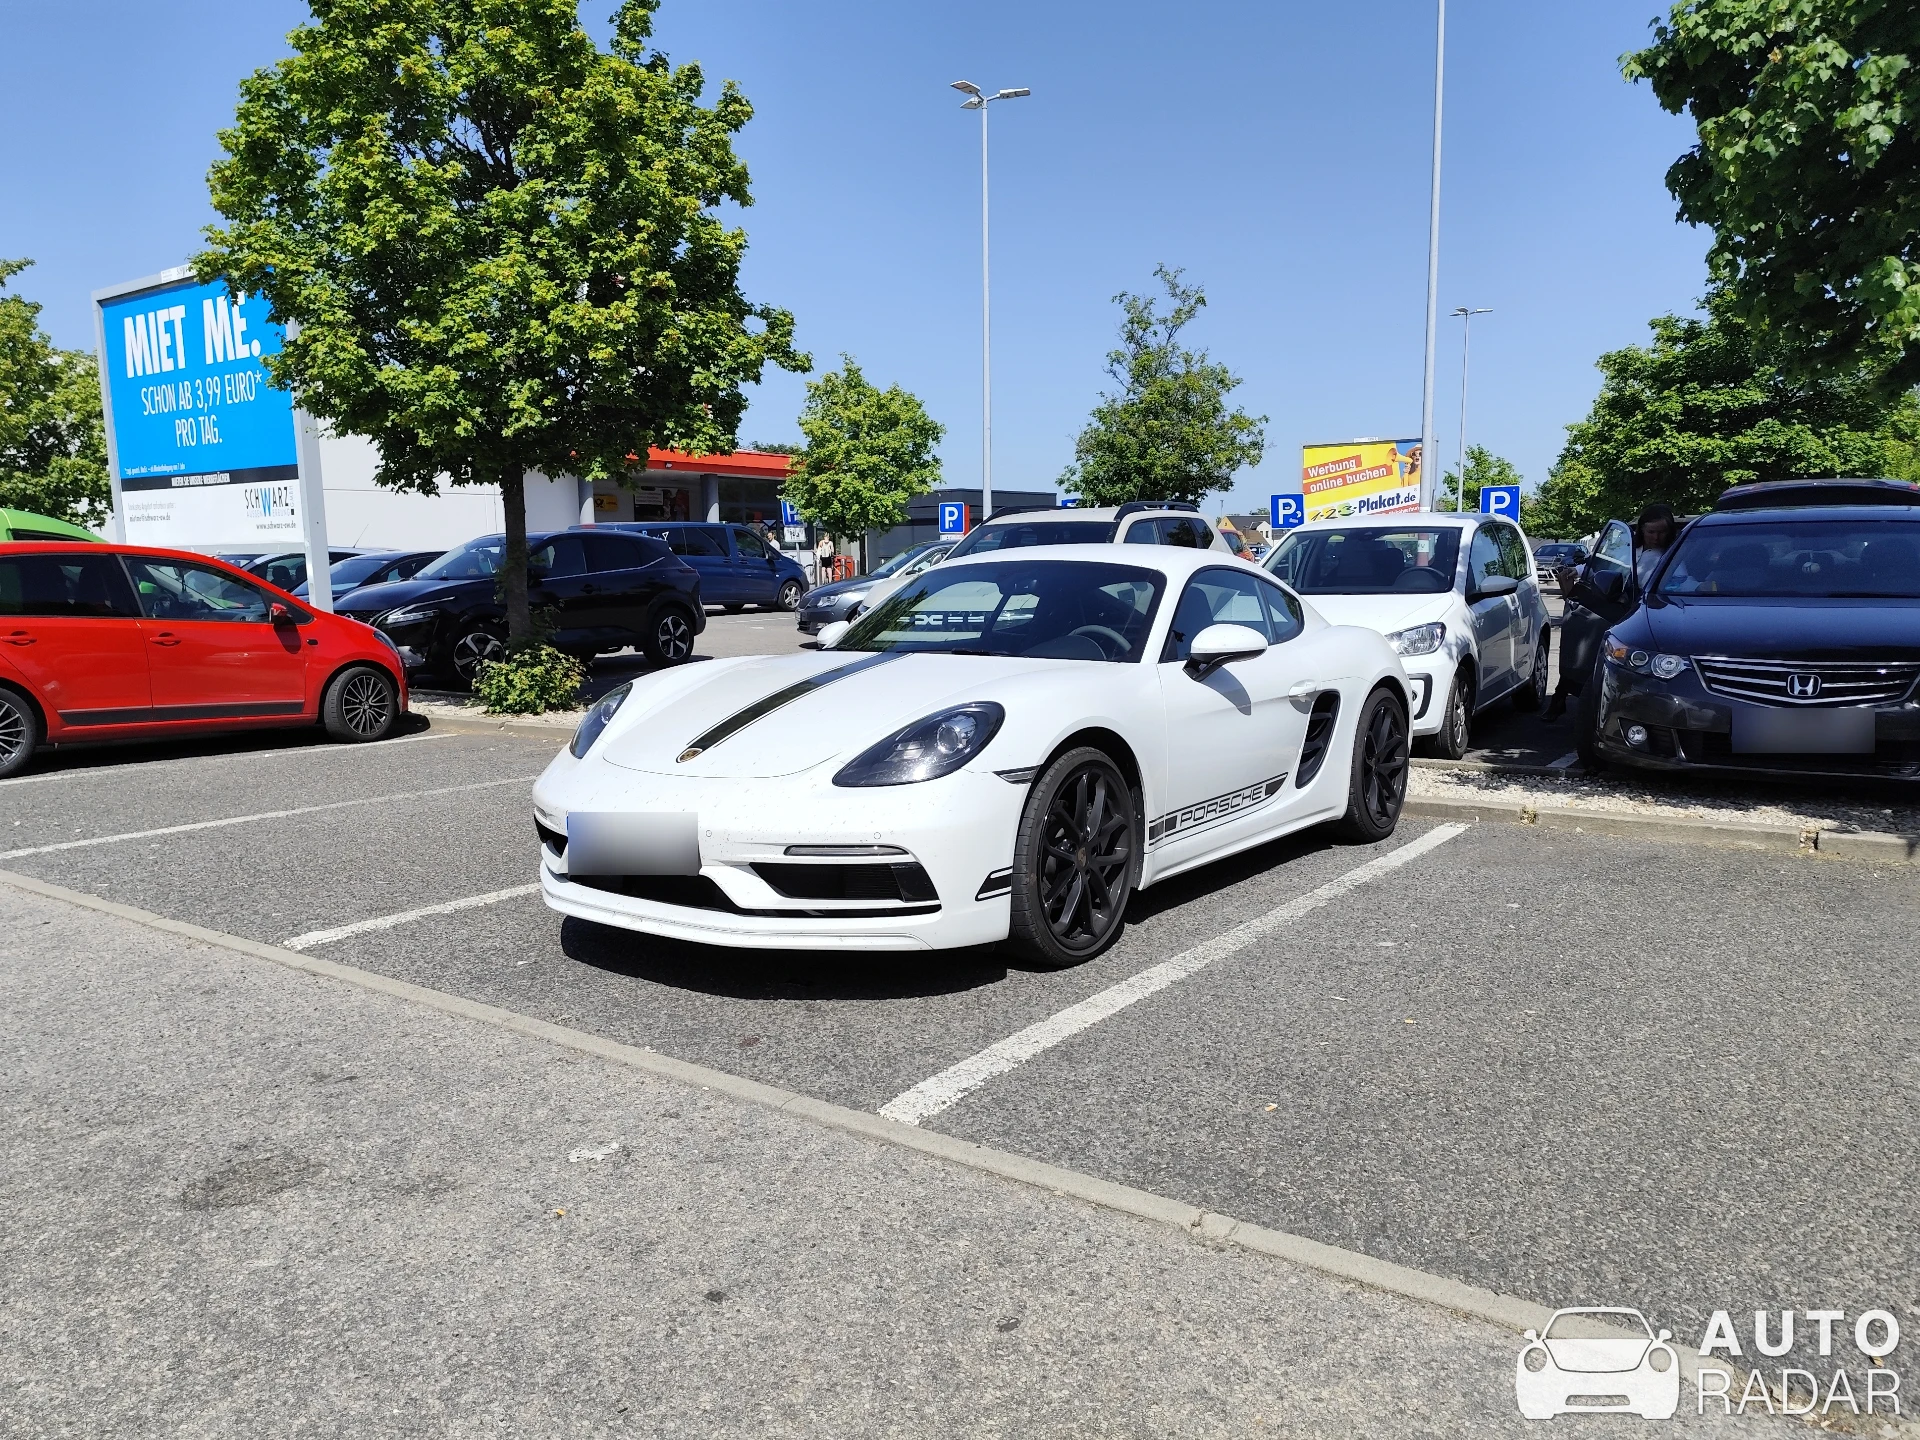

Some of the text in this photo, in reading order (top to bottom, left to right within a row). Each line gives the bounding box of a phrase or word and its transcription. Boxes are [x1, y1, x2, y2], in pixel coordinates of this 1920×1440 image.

[124, 291, 261, 379] MIET ME.
[141, 383, 176, 416] SCHON
[178, 380, 193, 411] AB
[195, 375, 221, 413] 3,99
[175, 414, 223, 448] PRO TAG.
[1308, 458, 1356, 478] Werbung
[1309, 466, 1387, 494] online buchen
[244, 486, 289, 517] SCHWARZ
[1278, 498, 1297, 525] P
[1490, 491, 1511, 514] P
[944, 506, 959, 530] P
[1179, 785, 1264, 827] PORSCHE
